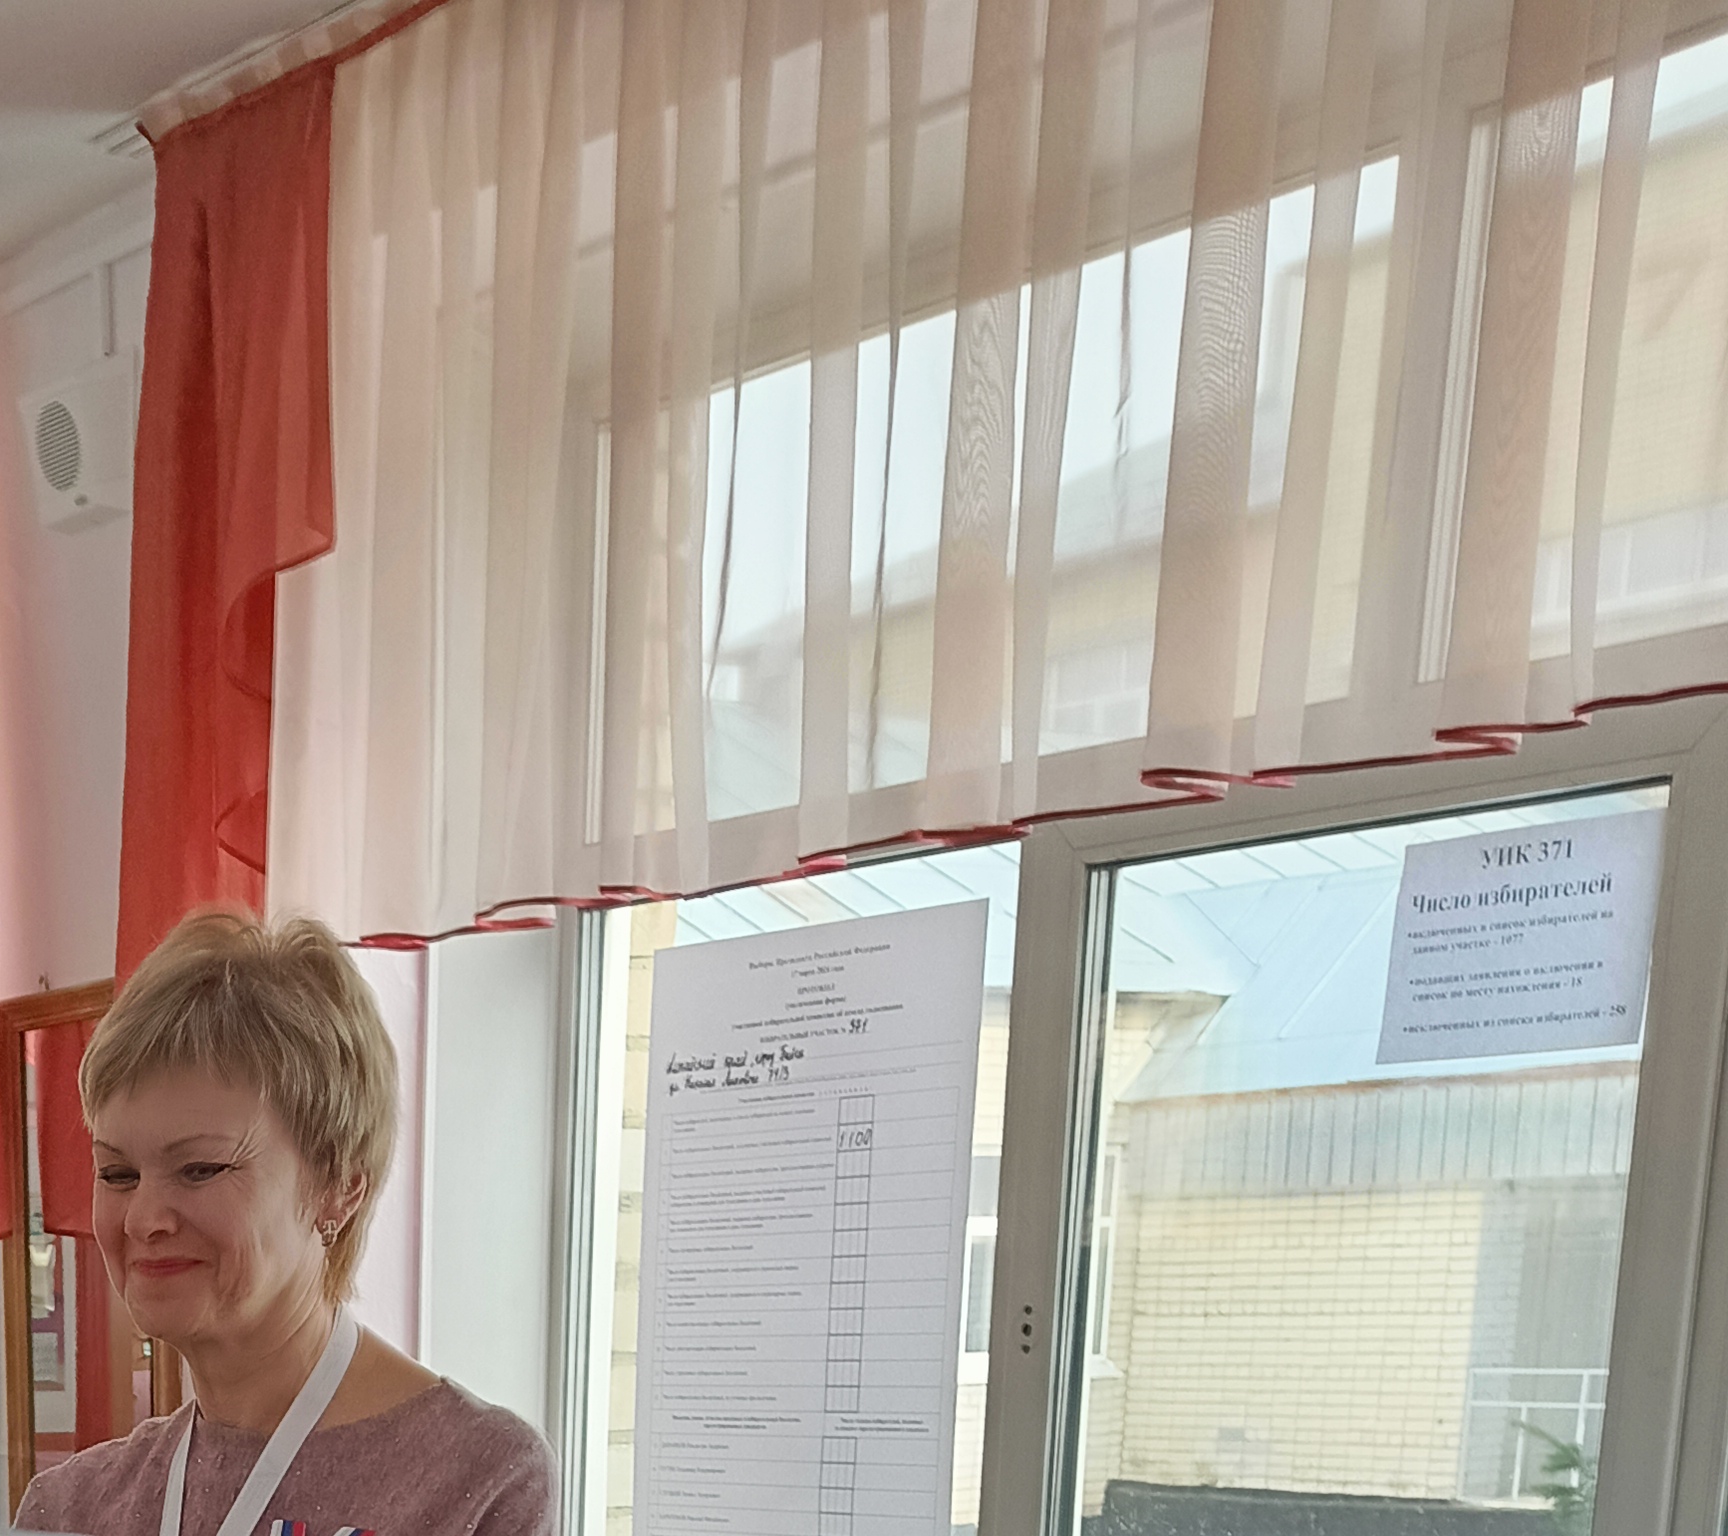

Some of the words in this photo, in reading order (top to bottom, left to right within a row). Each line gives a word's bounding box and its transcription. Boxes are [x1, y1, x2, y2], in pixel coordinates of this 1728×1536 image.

[1481, 843, 1531, 869] УИК
[1536, 838, 1572, 862] 371
[1412, 893, 1471, 913] Число
[1478, 872, 1611, 906] избирателей
[1412, 924, 1477, 939] включенных
[1488, 918, 1526, 931] список
[1528, 909, 1598, 927] избирателей
[1599, 909, 1614, 919] на
[1411, 943, 1448, 955] данном
[1449, 938, 1491, 954] участке
[1411, 990, 1448, 1002] список
[1449, 989, 1463, 999] по
[1464, 986, 1494, 997] месту
[1535, 1007, 1600, 1024] избирателей
